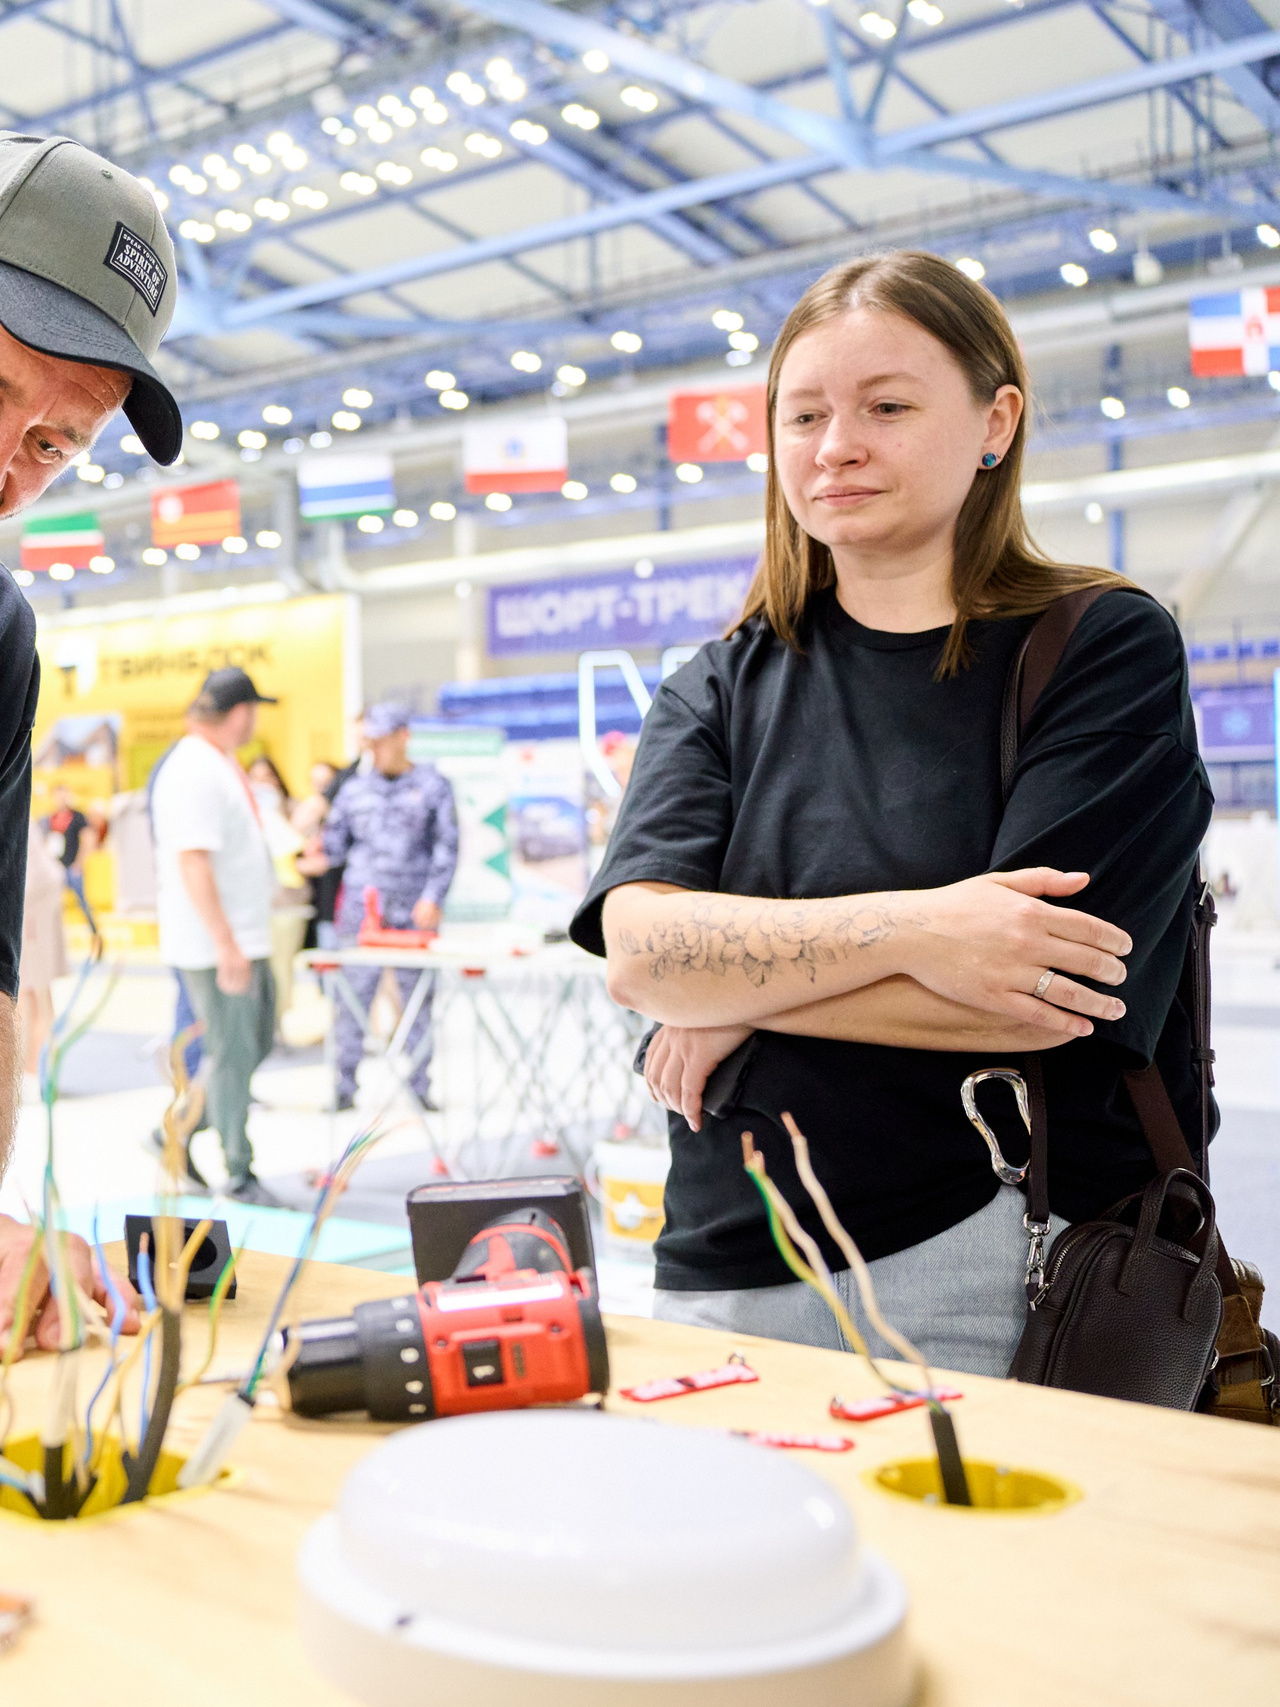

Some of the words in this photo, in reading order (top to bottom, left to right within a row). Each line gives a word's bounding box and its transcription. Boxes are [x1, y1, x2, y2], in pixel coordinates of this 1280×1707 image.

[123, 233, 141, 251] SPEAK
[143, 248, 156, 265] YOUR
[123, 244, 152, 274] SPIRIT
[151, 271, 161, 286] OF
[116, 252, 158, 300] ADVENTURE
